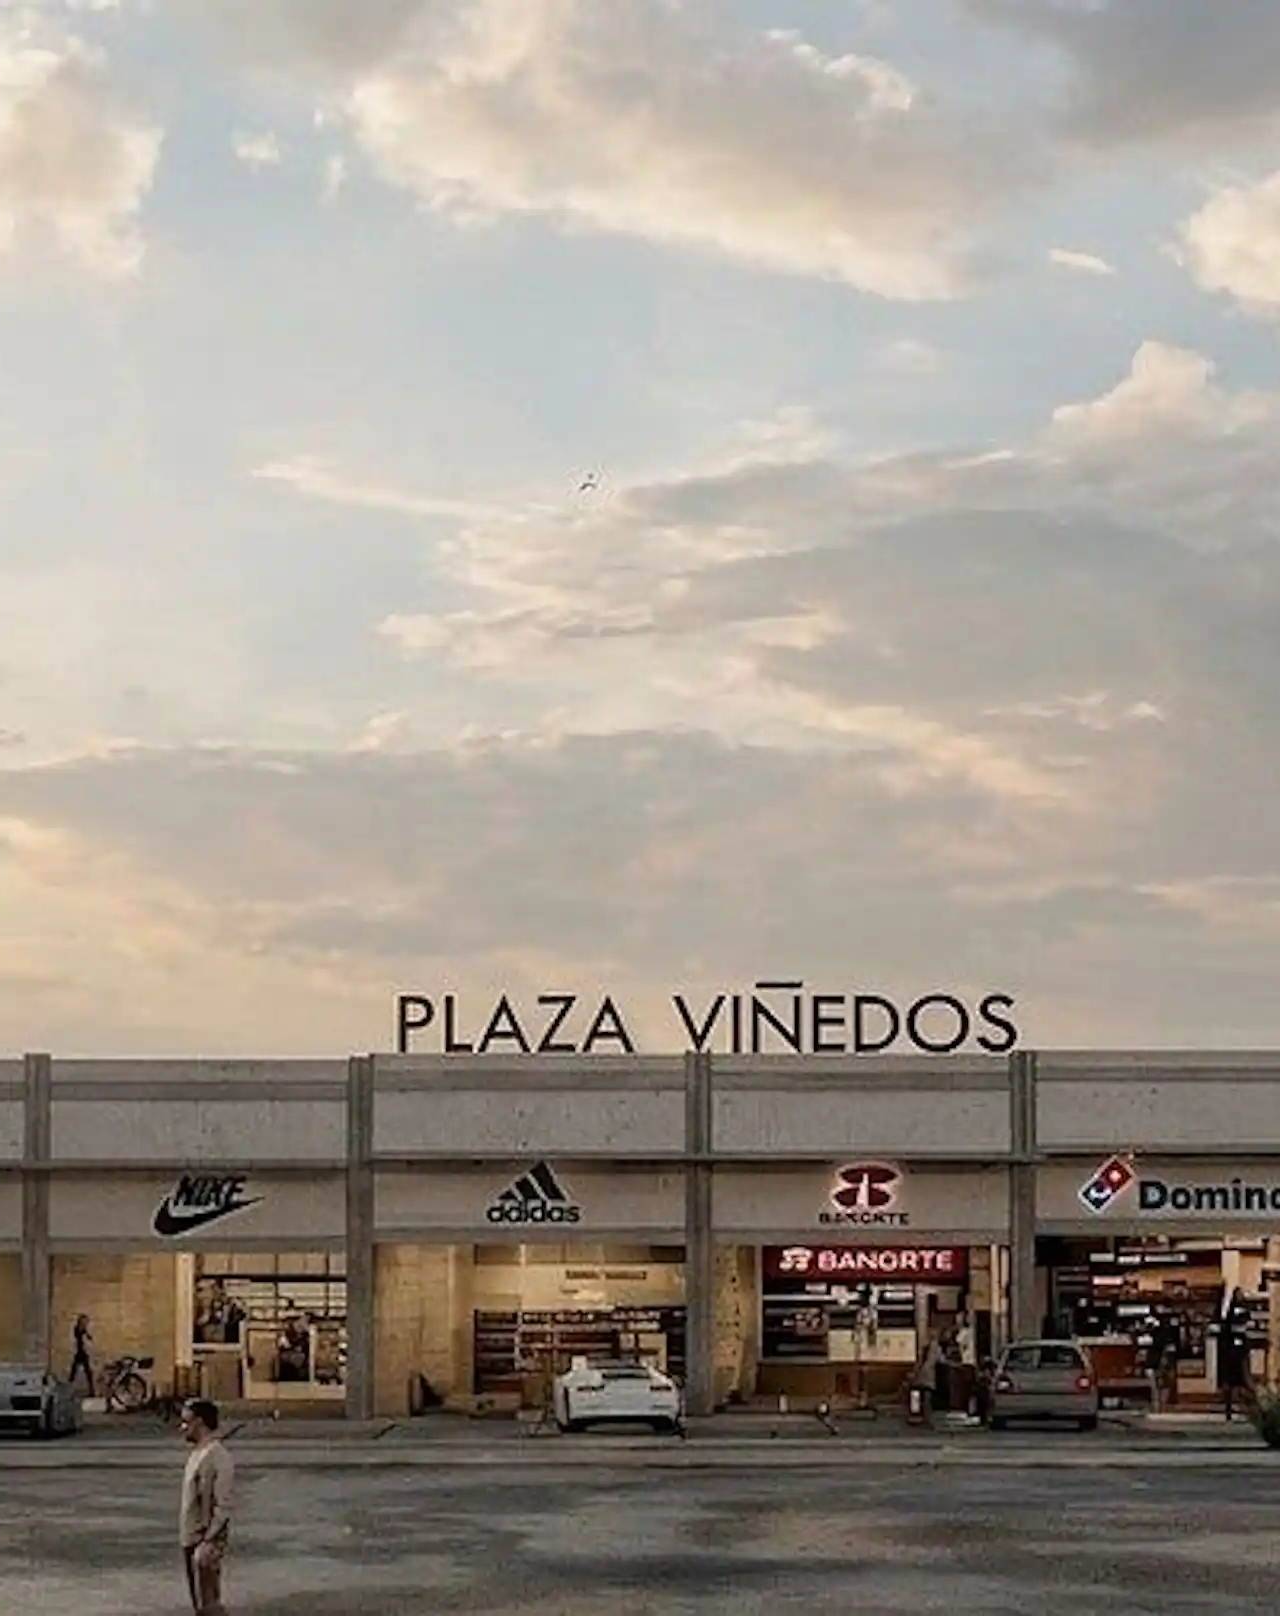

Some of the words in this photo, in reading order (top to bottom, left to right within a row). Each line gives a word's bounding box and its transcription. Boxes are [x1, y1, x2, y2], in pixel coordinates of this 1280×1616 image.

[399, 995, 635, 1053] PLAZA
[672, 982, 1018, 1053] VIÑEDOS
[486, 1199, 581, 1223] adidas
[817, 1250, 954, 1272] BANORTE
